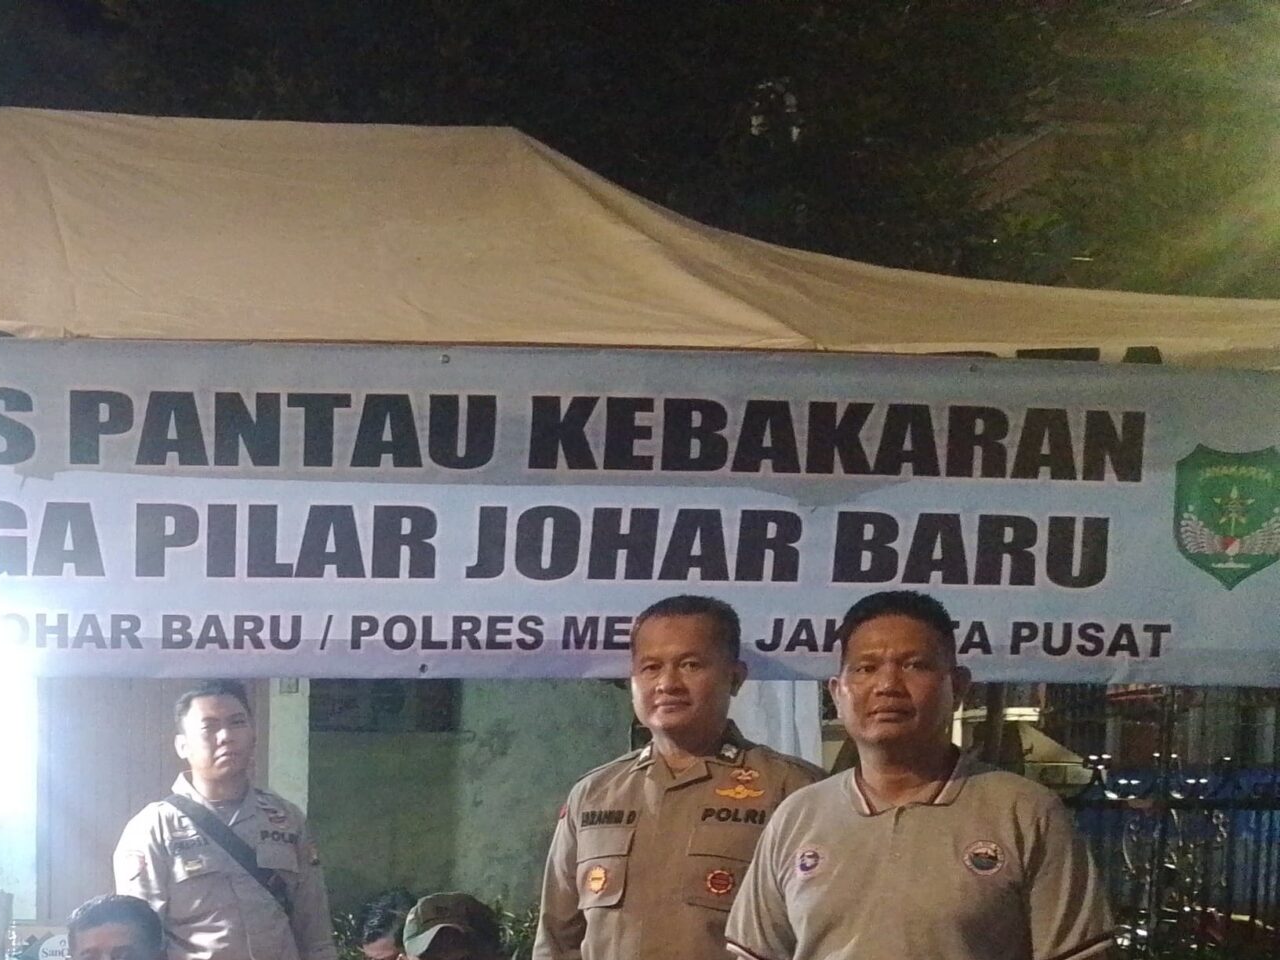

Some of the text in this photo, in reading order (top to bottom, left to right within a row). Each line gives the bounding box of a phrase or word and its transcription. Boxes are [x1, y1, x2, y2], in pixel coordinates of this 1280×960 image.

[69, 388, 497, 470] PANTAU
[527, 395, 1146, 483] KEBAKARAN
[135, 502, 438, 579] PILAR
[465, 504, 803, 583] JOHAR
[831, 510, 1110, 589] BARU
[0, 612, 142, 651] OHAR
[160, 613, 303, 651] BARU
[319, 613, 333, 652] /
[349, 614, 546, 652] POLRES
[1010, 620, 1172, 659] PUSAT
[700, 806, 767, 826] POLRI
